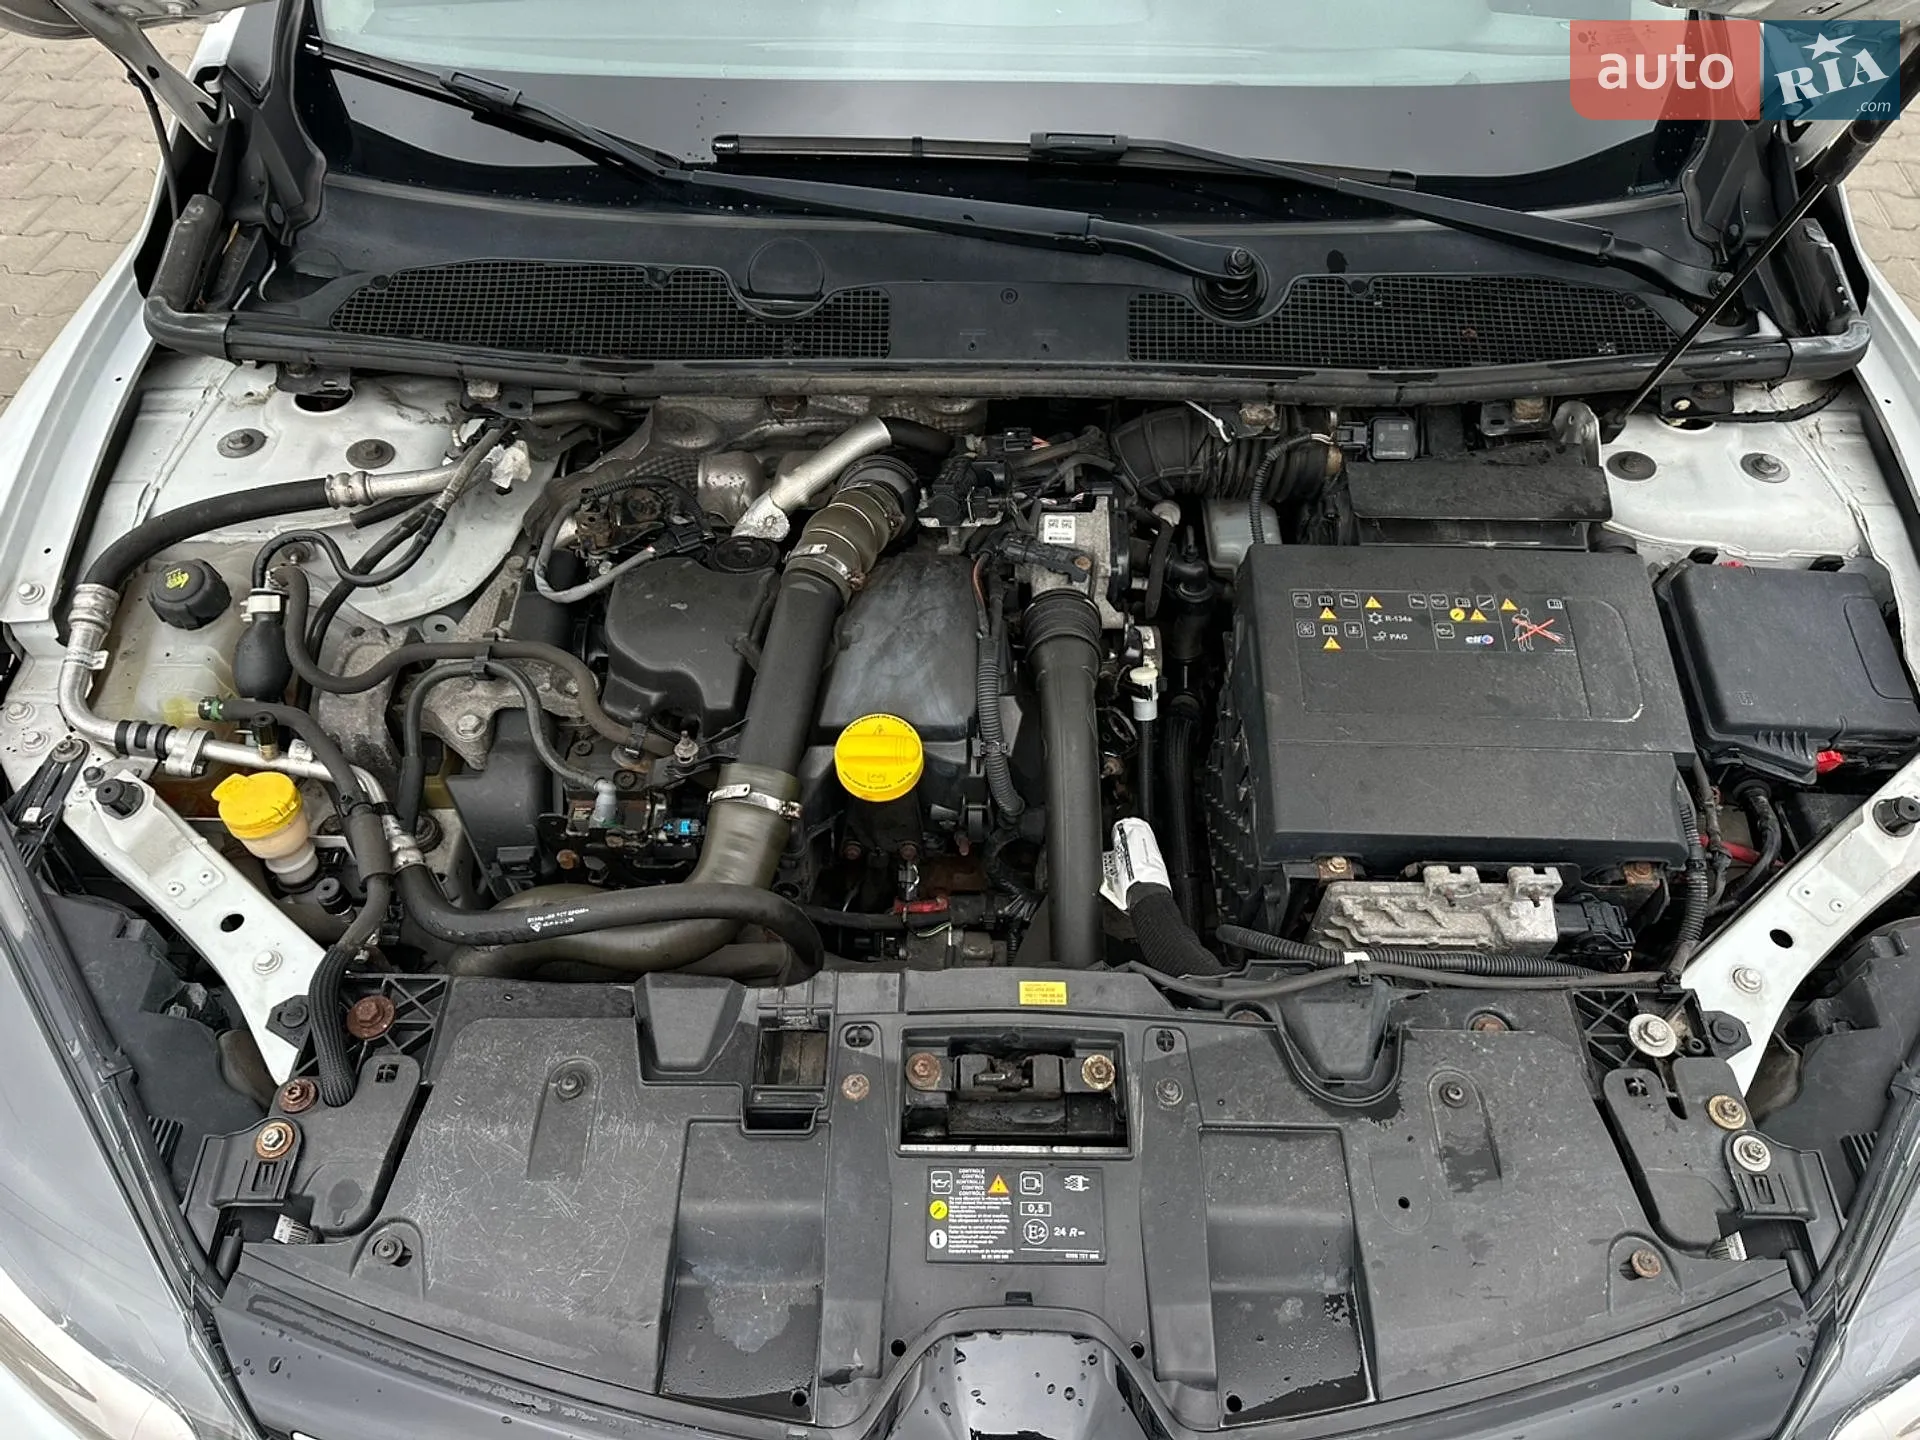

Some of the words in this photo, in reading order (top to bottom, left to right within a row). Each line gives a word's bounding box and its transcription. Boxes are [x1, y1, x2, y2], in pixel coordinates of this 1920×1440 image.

[1027, 1203, 1044, 1216] 0,5
[1028, 1225, 1046, 1239] E2
[1053, 1226, 1067, 1236] 24
